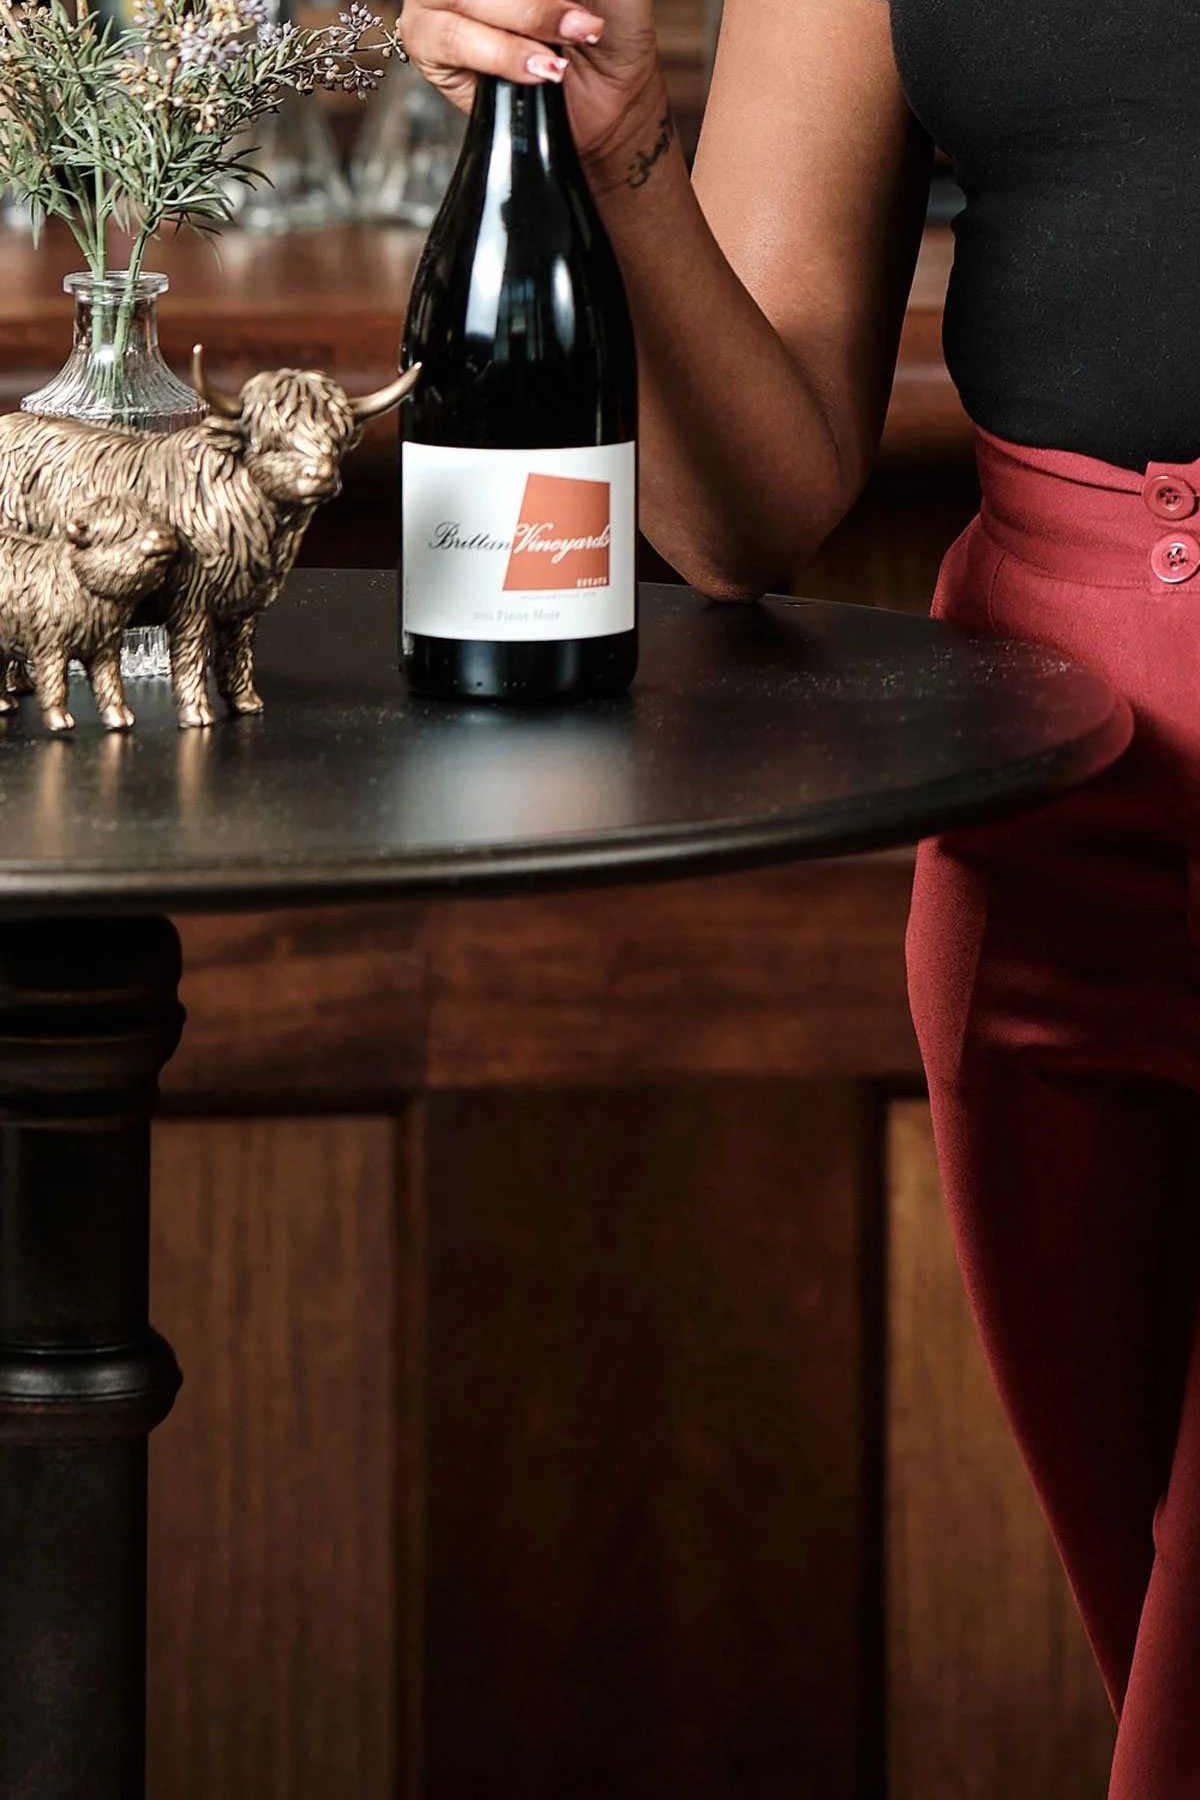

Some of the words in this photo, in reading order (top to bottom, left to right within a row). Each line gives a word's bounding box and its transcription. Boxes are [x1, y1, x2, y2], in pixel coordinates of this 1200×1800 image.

[429, 521, 512, 550] Brittan
[514, 522, 611, 564] Vineyards
[494, 609, 528, 623] Pinot
[533, 609, 561, 622] Noir
